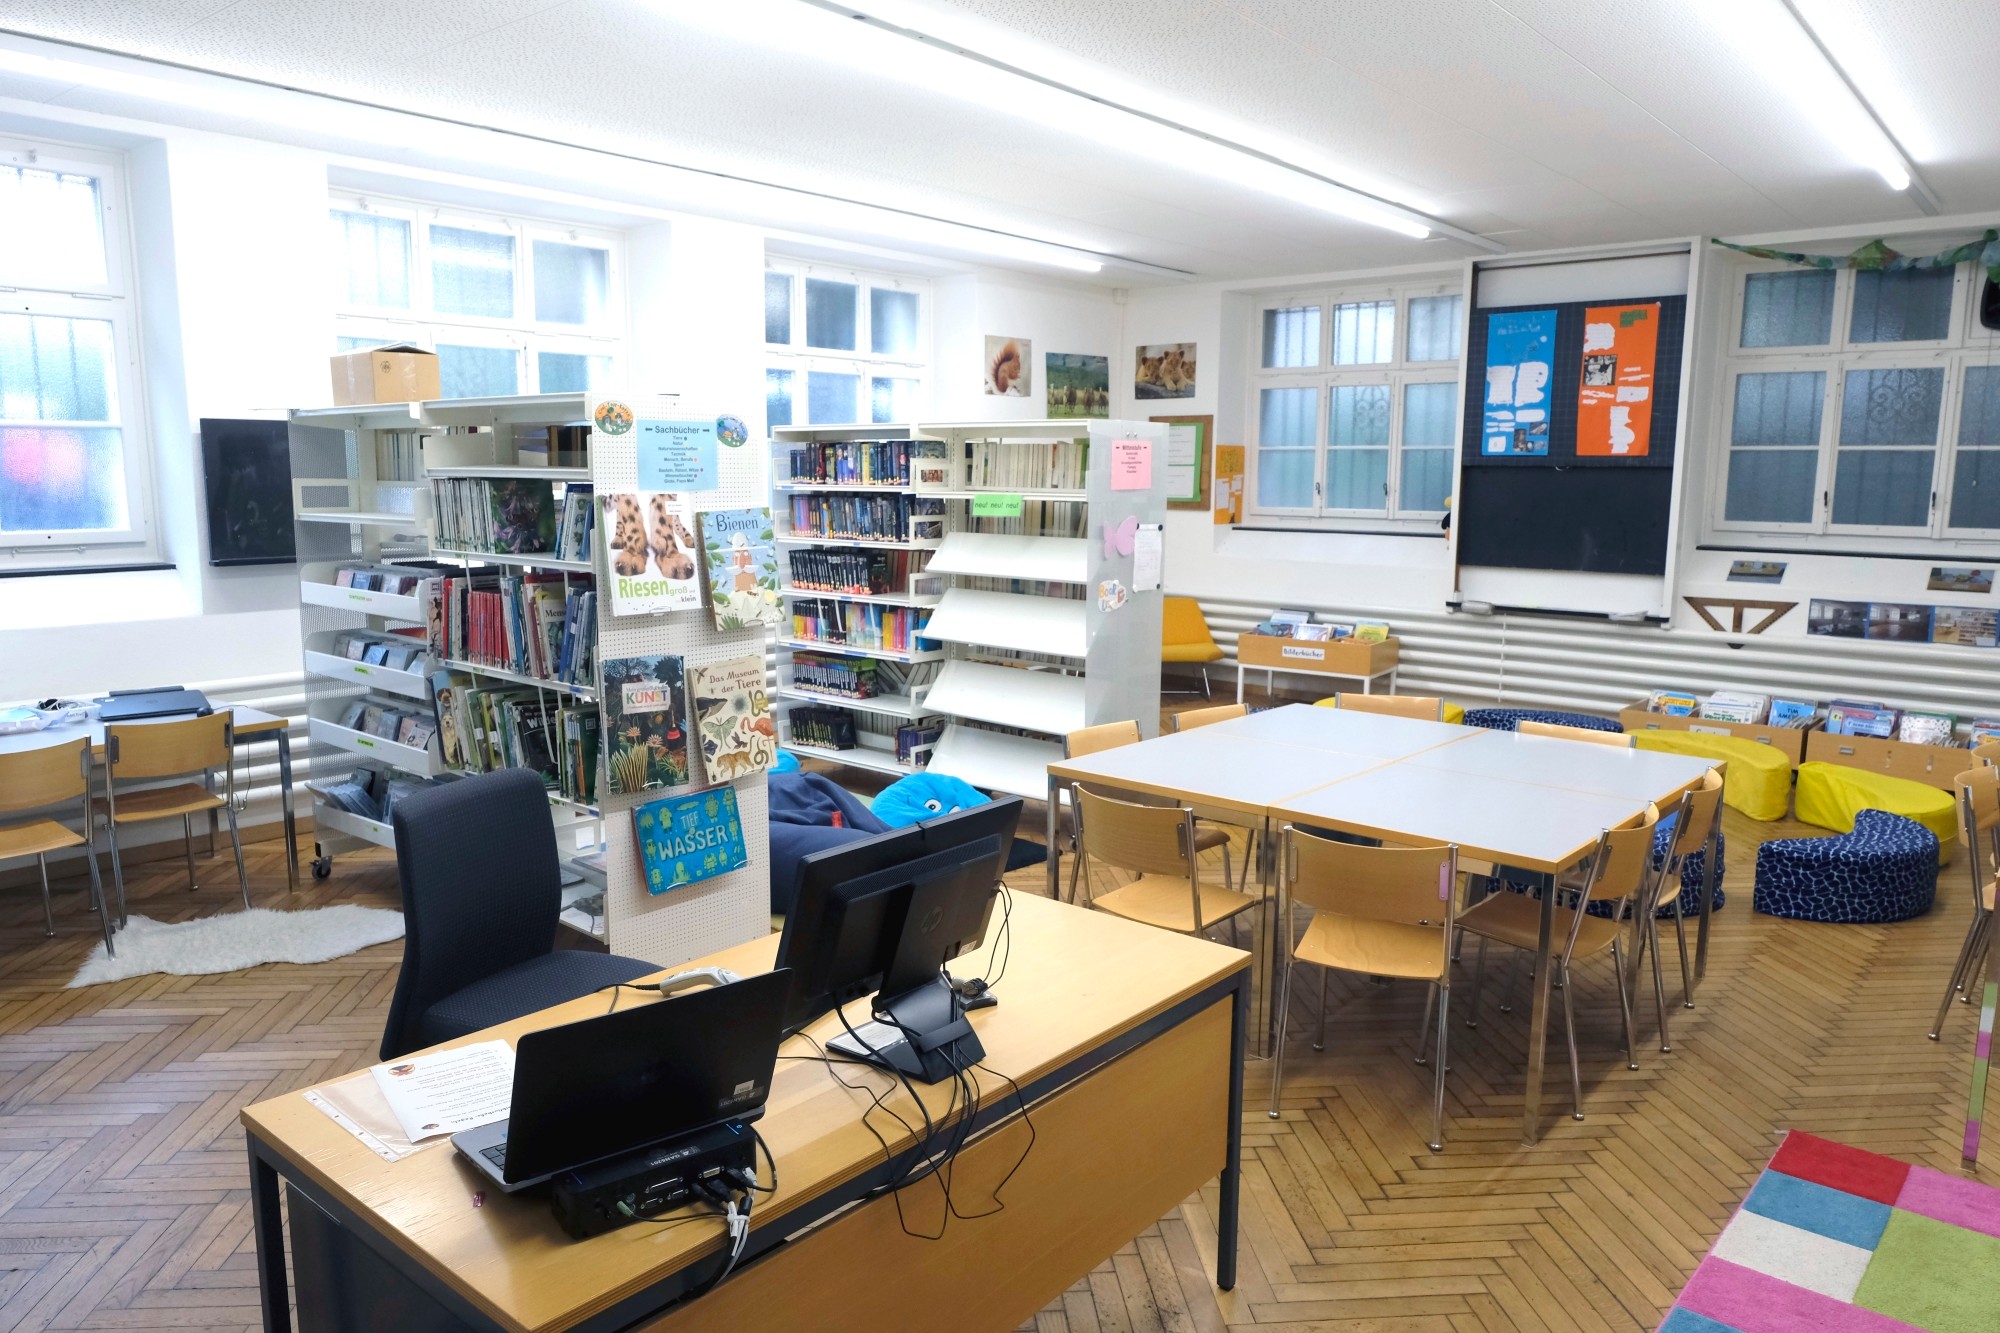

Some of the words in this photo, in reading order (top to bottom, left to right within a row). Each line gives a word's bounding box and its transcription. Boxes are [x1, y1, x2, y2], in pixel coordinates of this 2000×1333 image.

[655, 425, 700, 434] Sachbücher
[715, 513, 758, 532] Bienen
[618, 578, 669, 598] Riesen
[1283, 648, 1324, 658] Bilderbücher
[709, 675, 725, 684] Das
[726, 669, 760, 680] Museum
[735, 679, 761, 690] Tiere
[626, 690, 667, 704] KUNST
[680, 811, 699, 829] TIEF
[657, 825, 729, 861] WASSER
